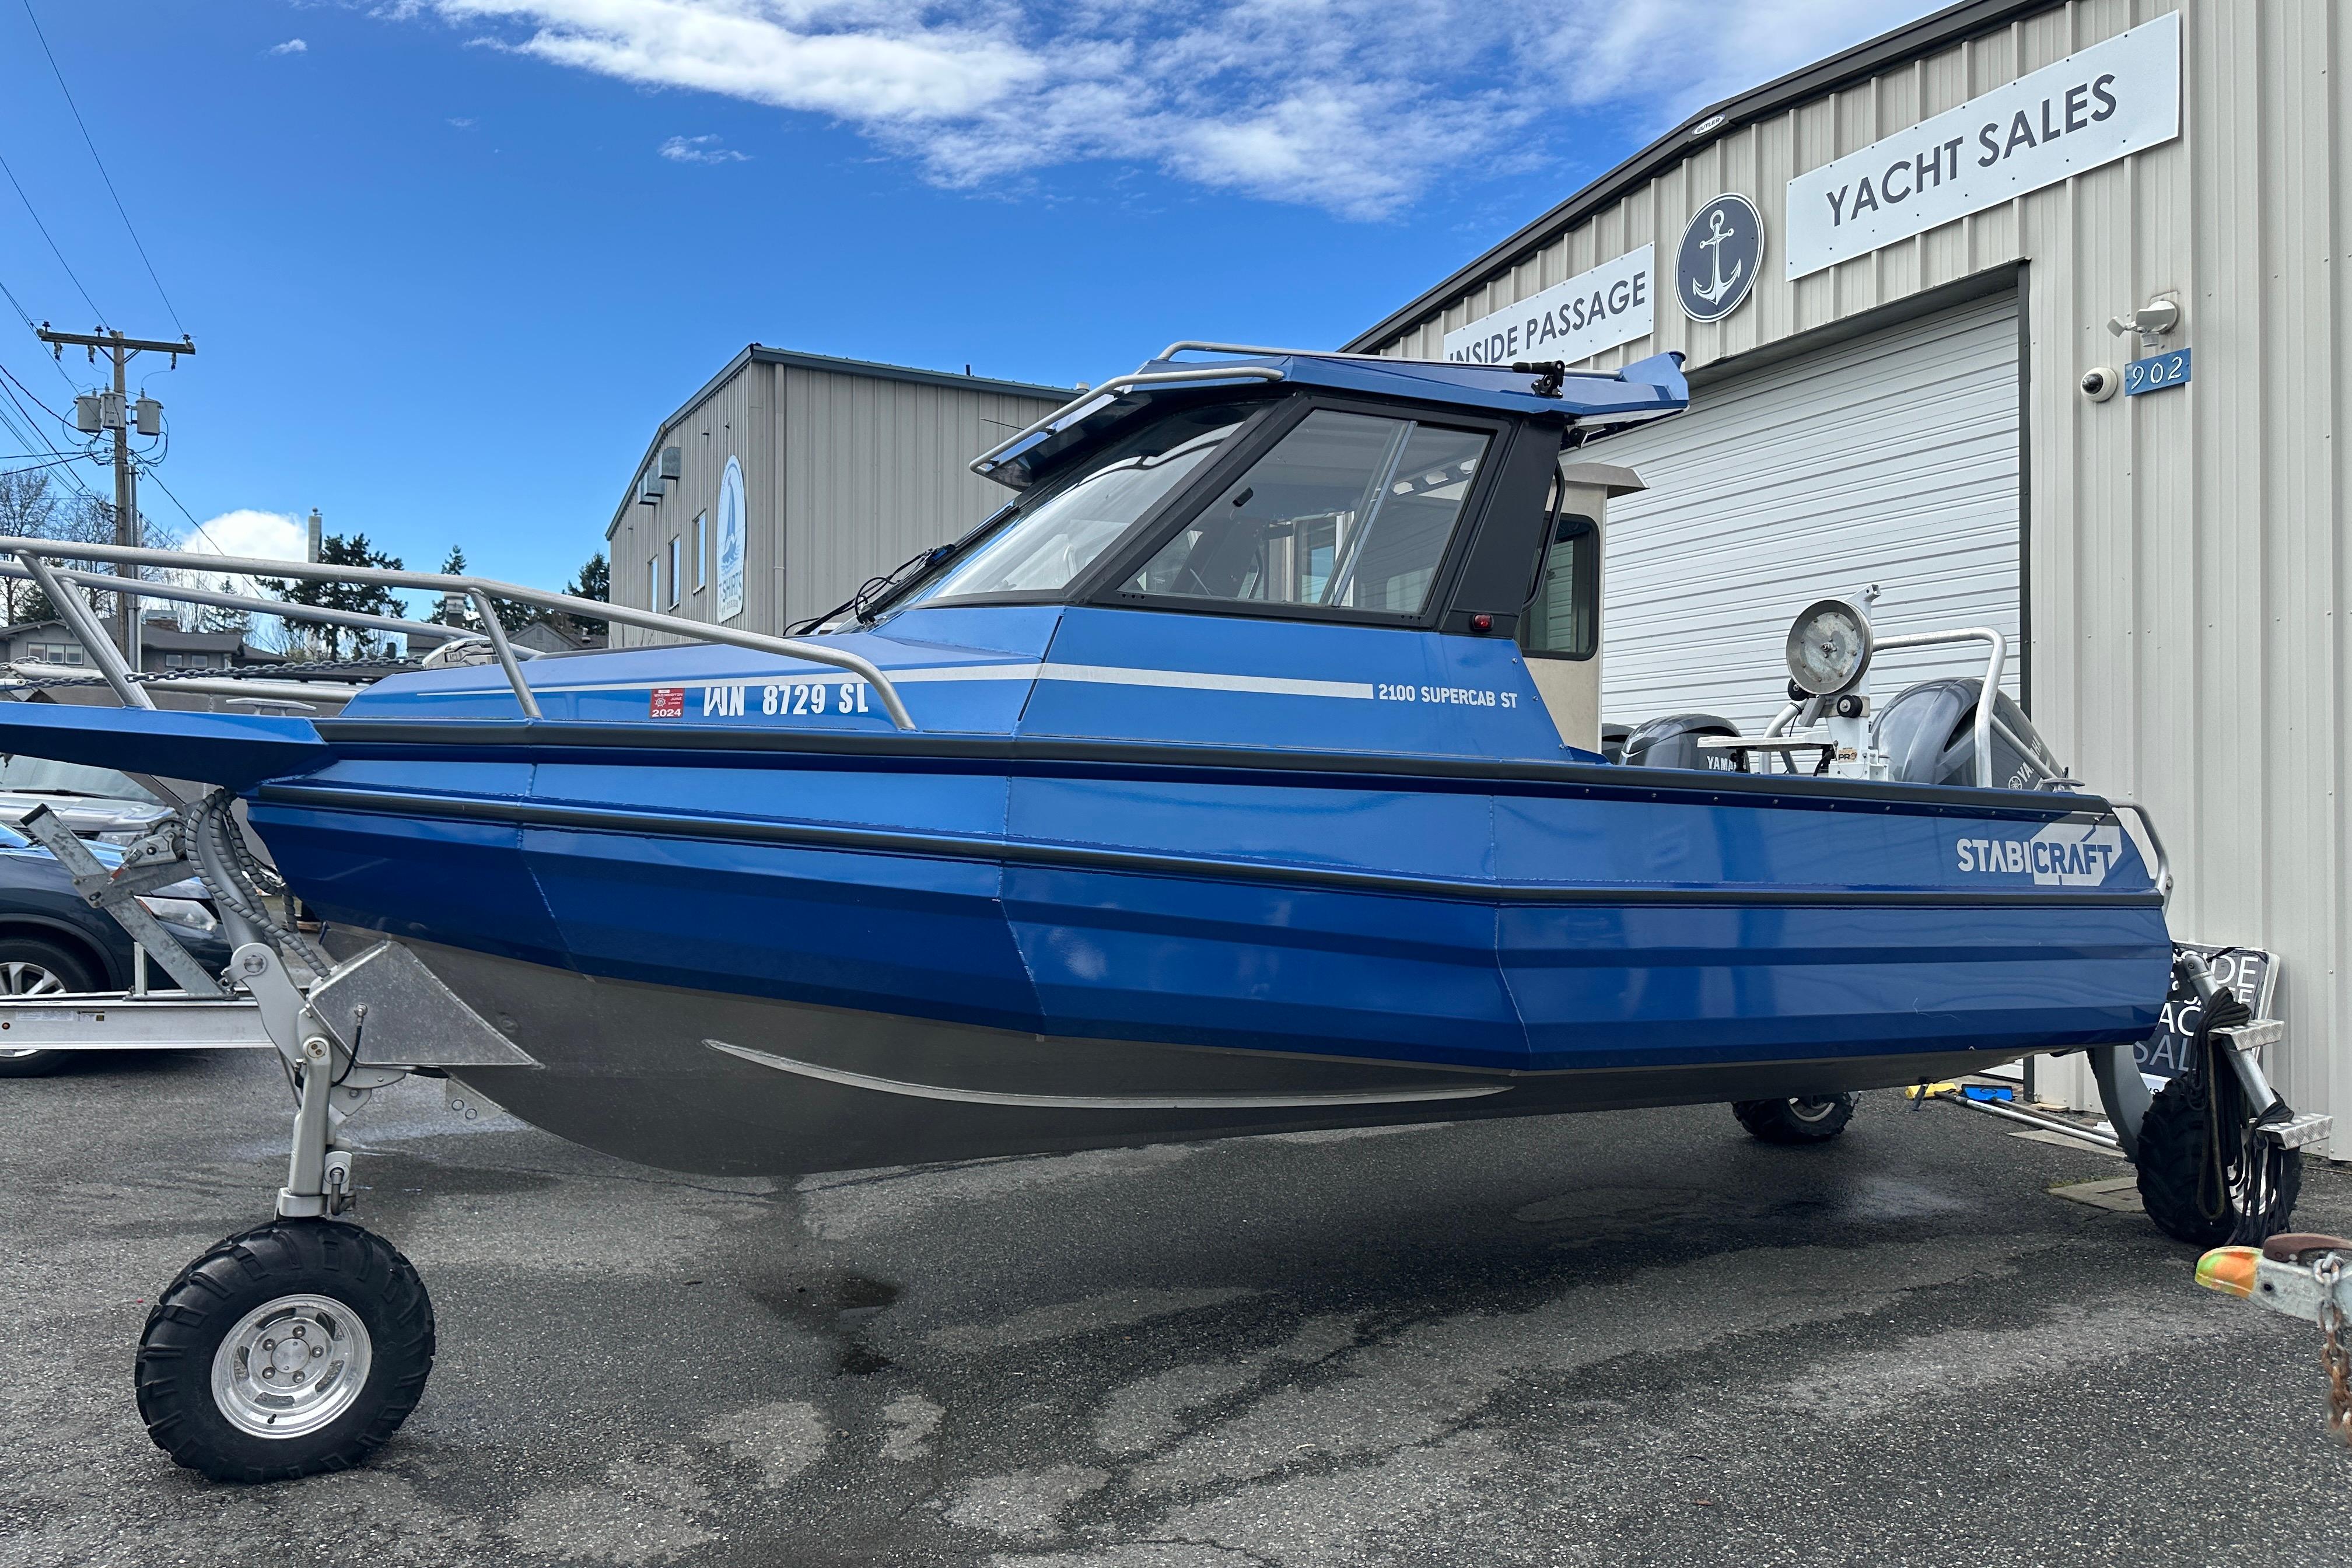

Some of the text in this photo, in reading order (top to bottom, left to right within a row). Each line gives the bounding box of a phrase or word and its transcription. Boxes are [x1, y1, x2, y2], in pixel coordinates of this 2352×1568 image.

[1696, 117, 1720, 133] BUTLER
[1826, 74, 2116, 227] YACHT SALES
[1450, 271, 1646, 364] SIDE PASSAGE
[2131, 356, 2182, 390] 902
[704, 683, 869, 716] WN 8729 SL
[1378, 684, 1517, 708] 2100 SUPERCAB ST
[652, 708, 681, 718] 2024
[1957, 838, 2112, 875] STABICRAFT
